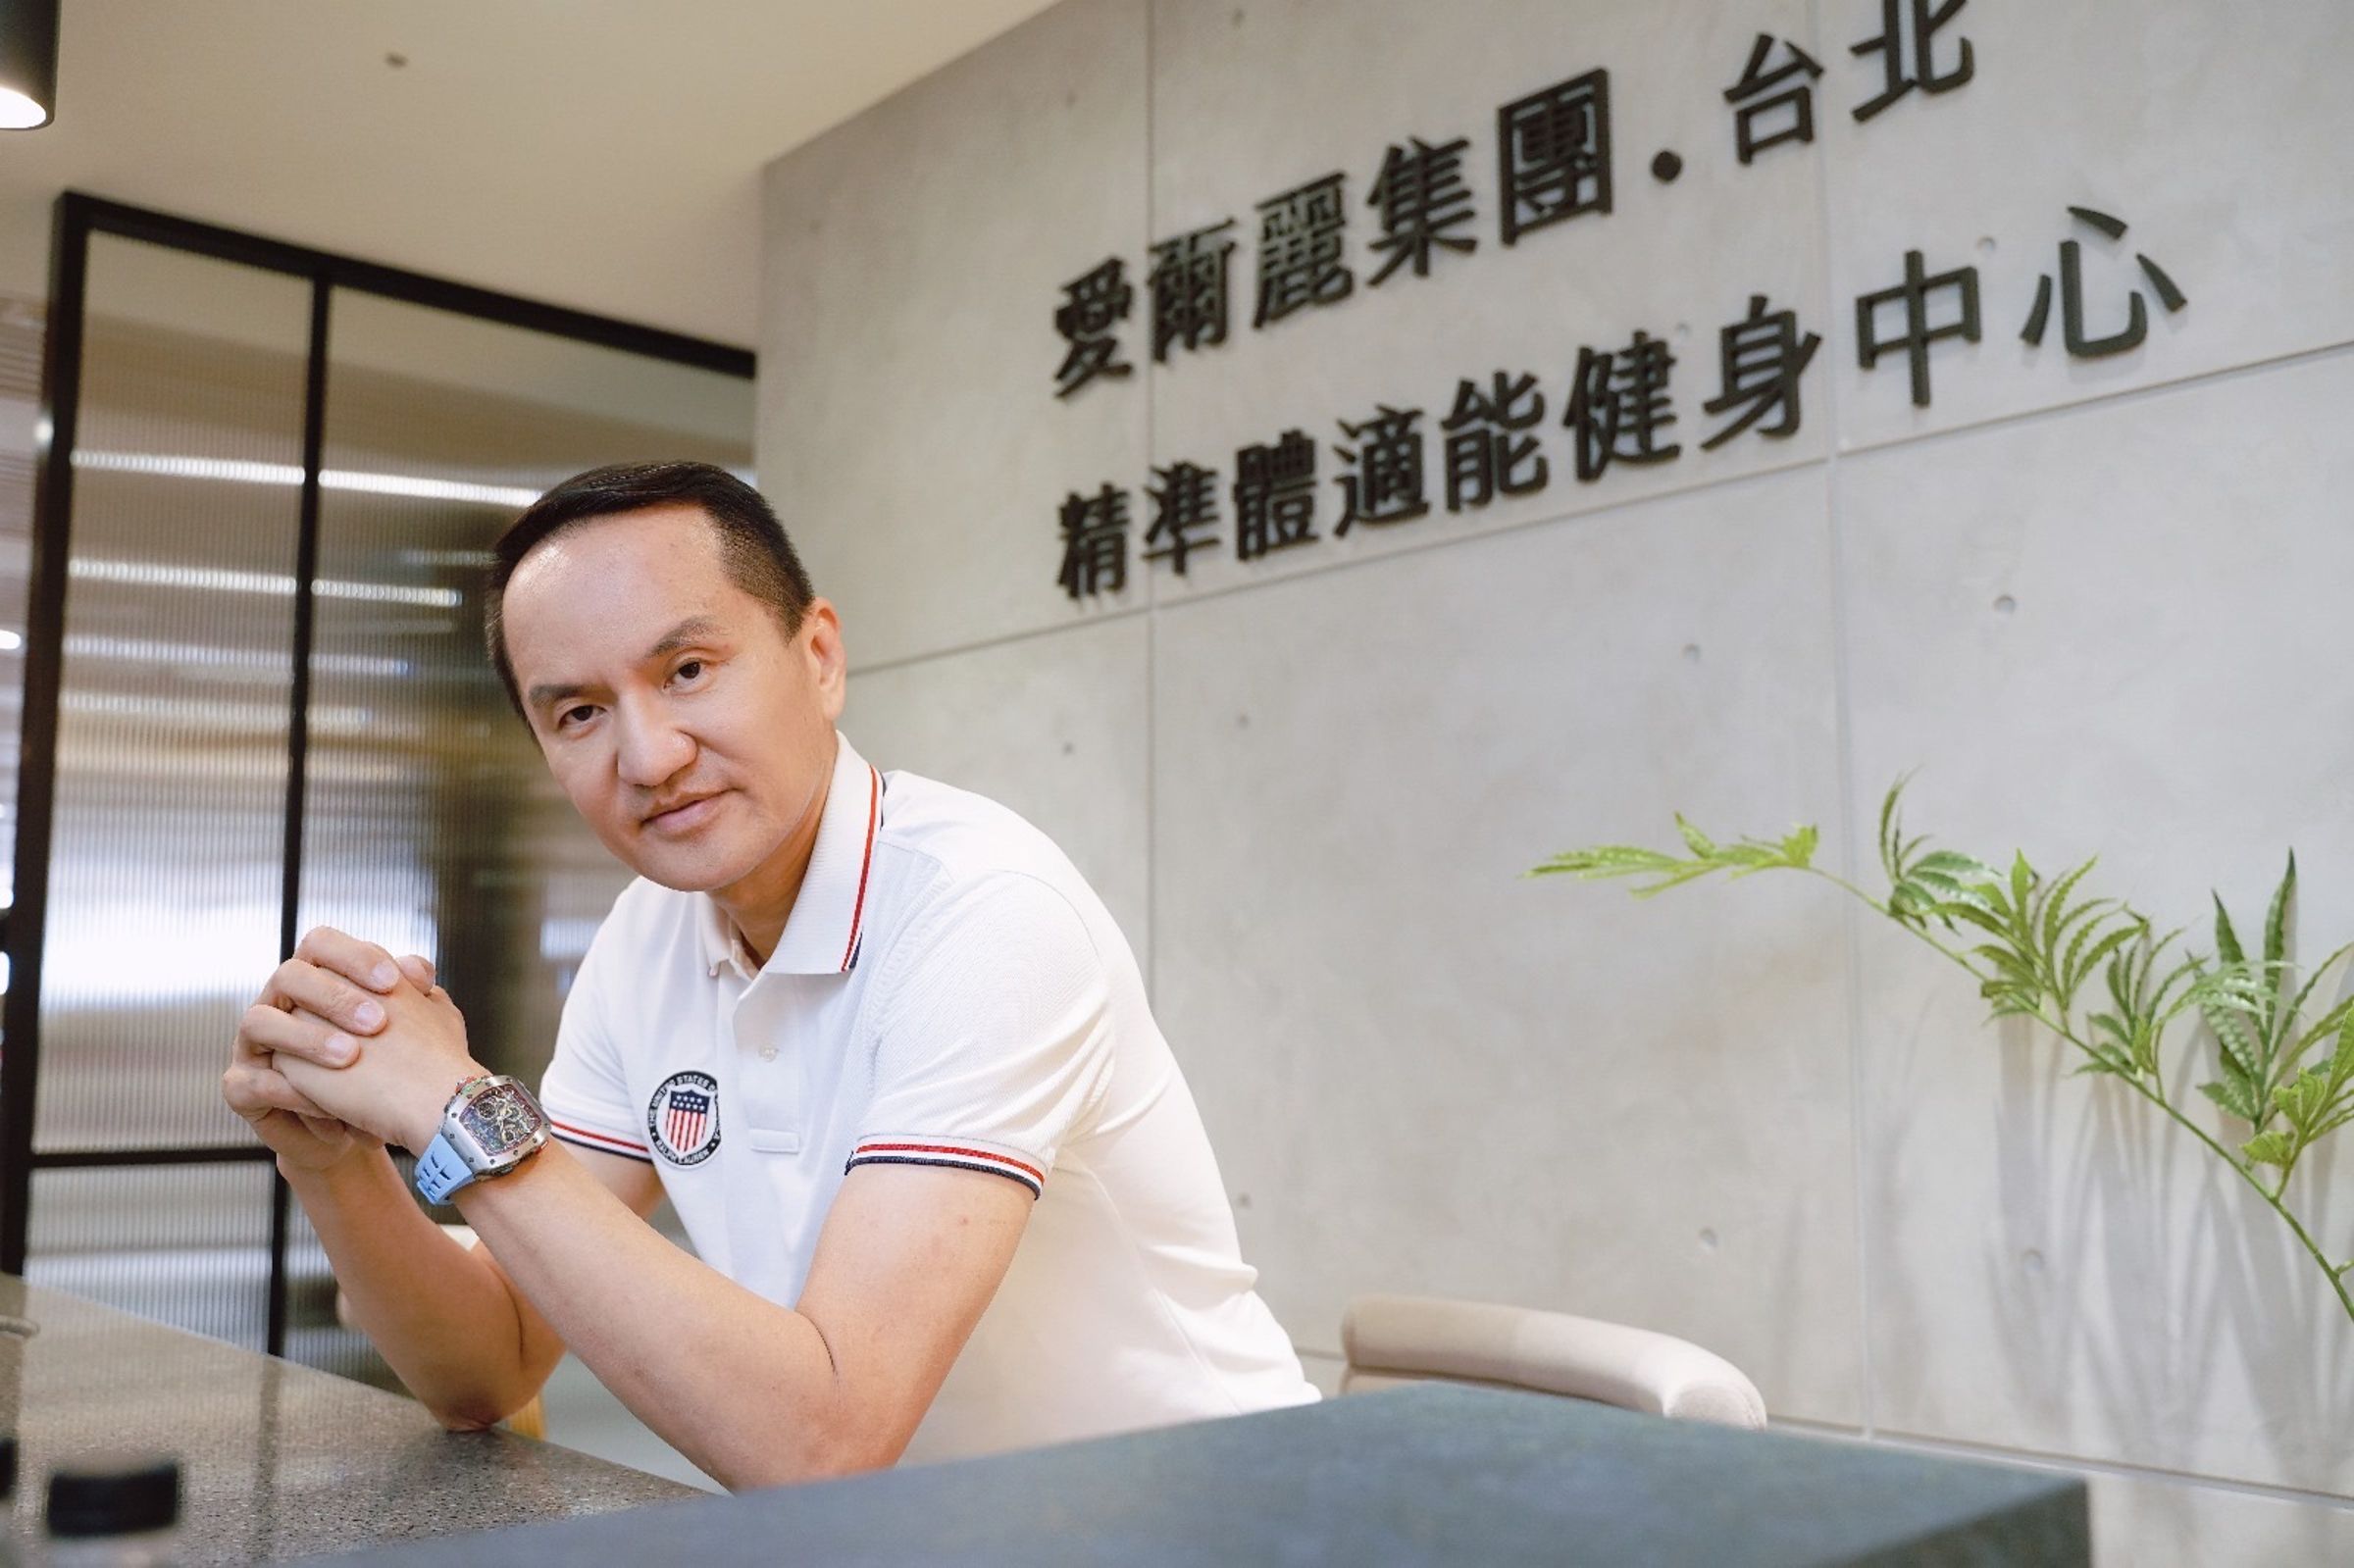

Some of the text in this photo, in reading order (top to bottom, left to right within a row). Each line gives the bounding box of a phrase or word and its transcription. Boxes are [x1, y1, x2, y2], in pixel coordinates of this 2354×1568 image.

[1056, 206, 2188, 601] 精準體適能健身中心
[676, 1074, 709, 1088] STATES
